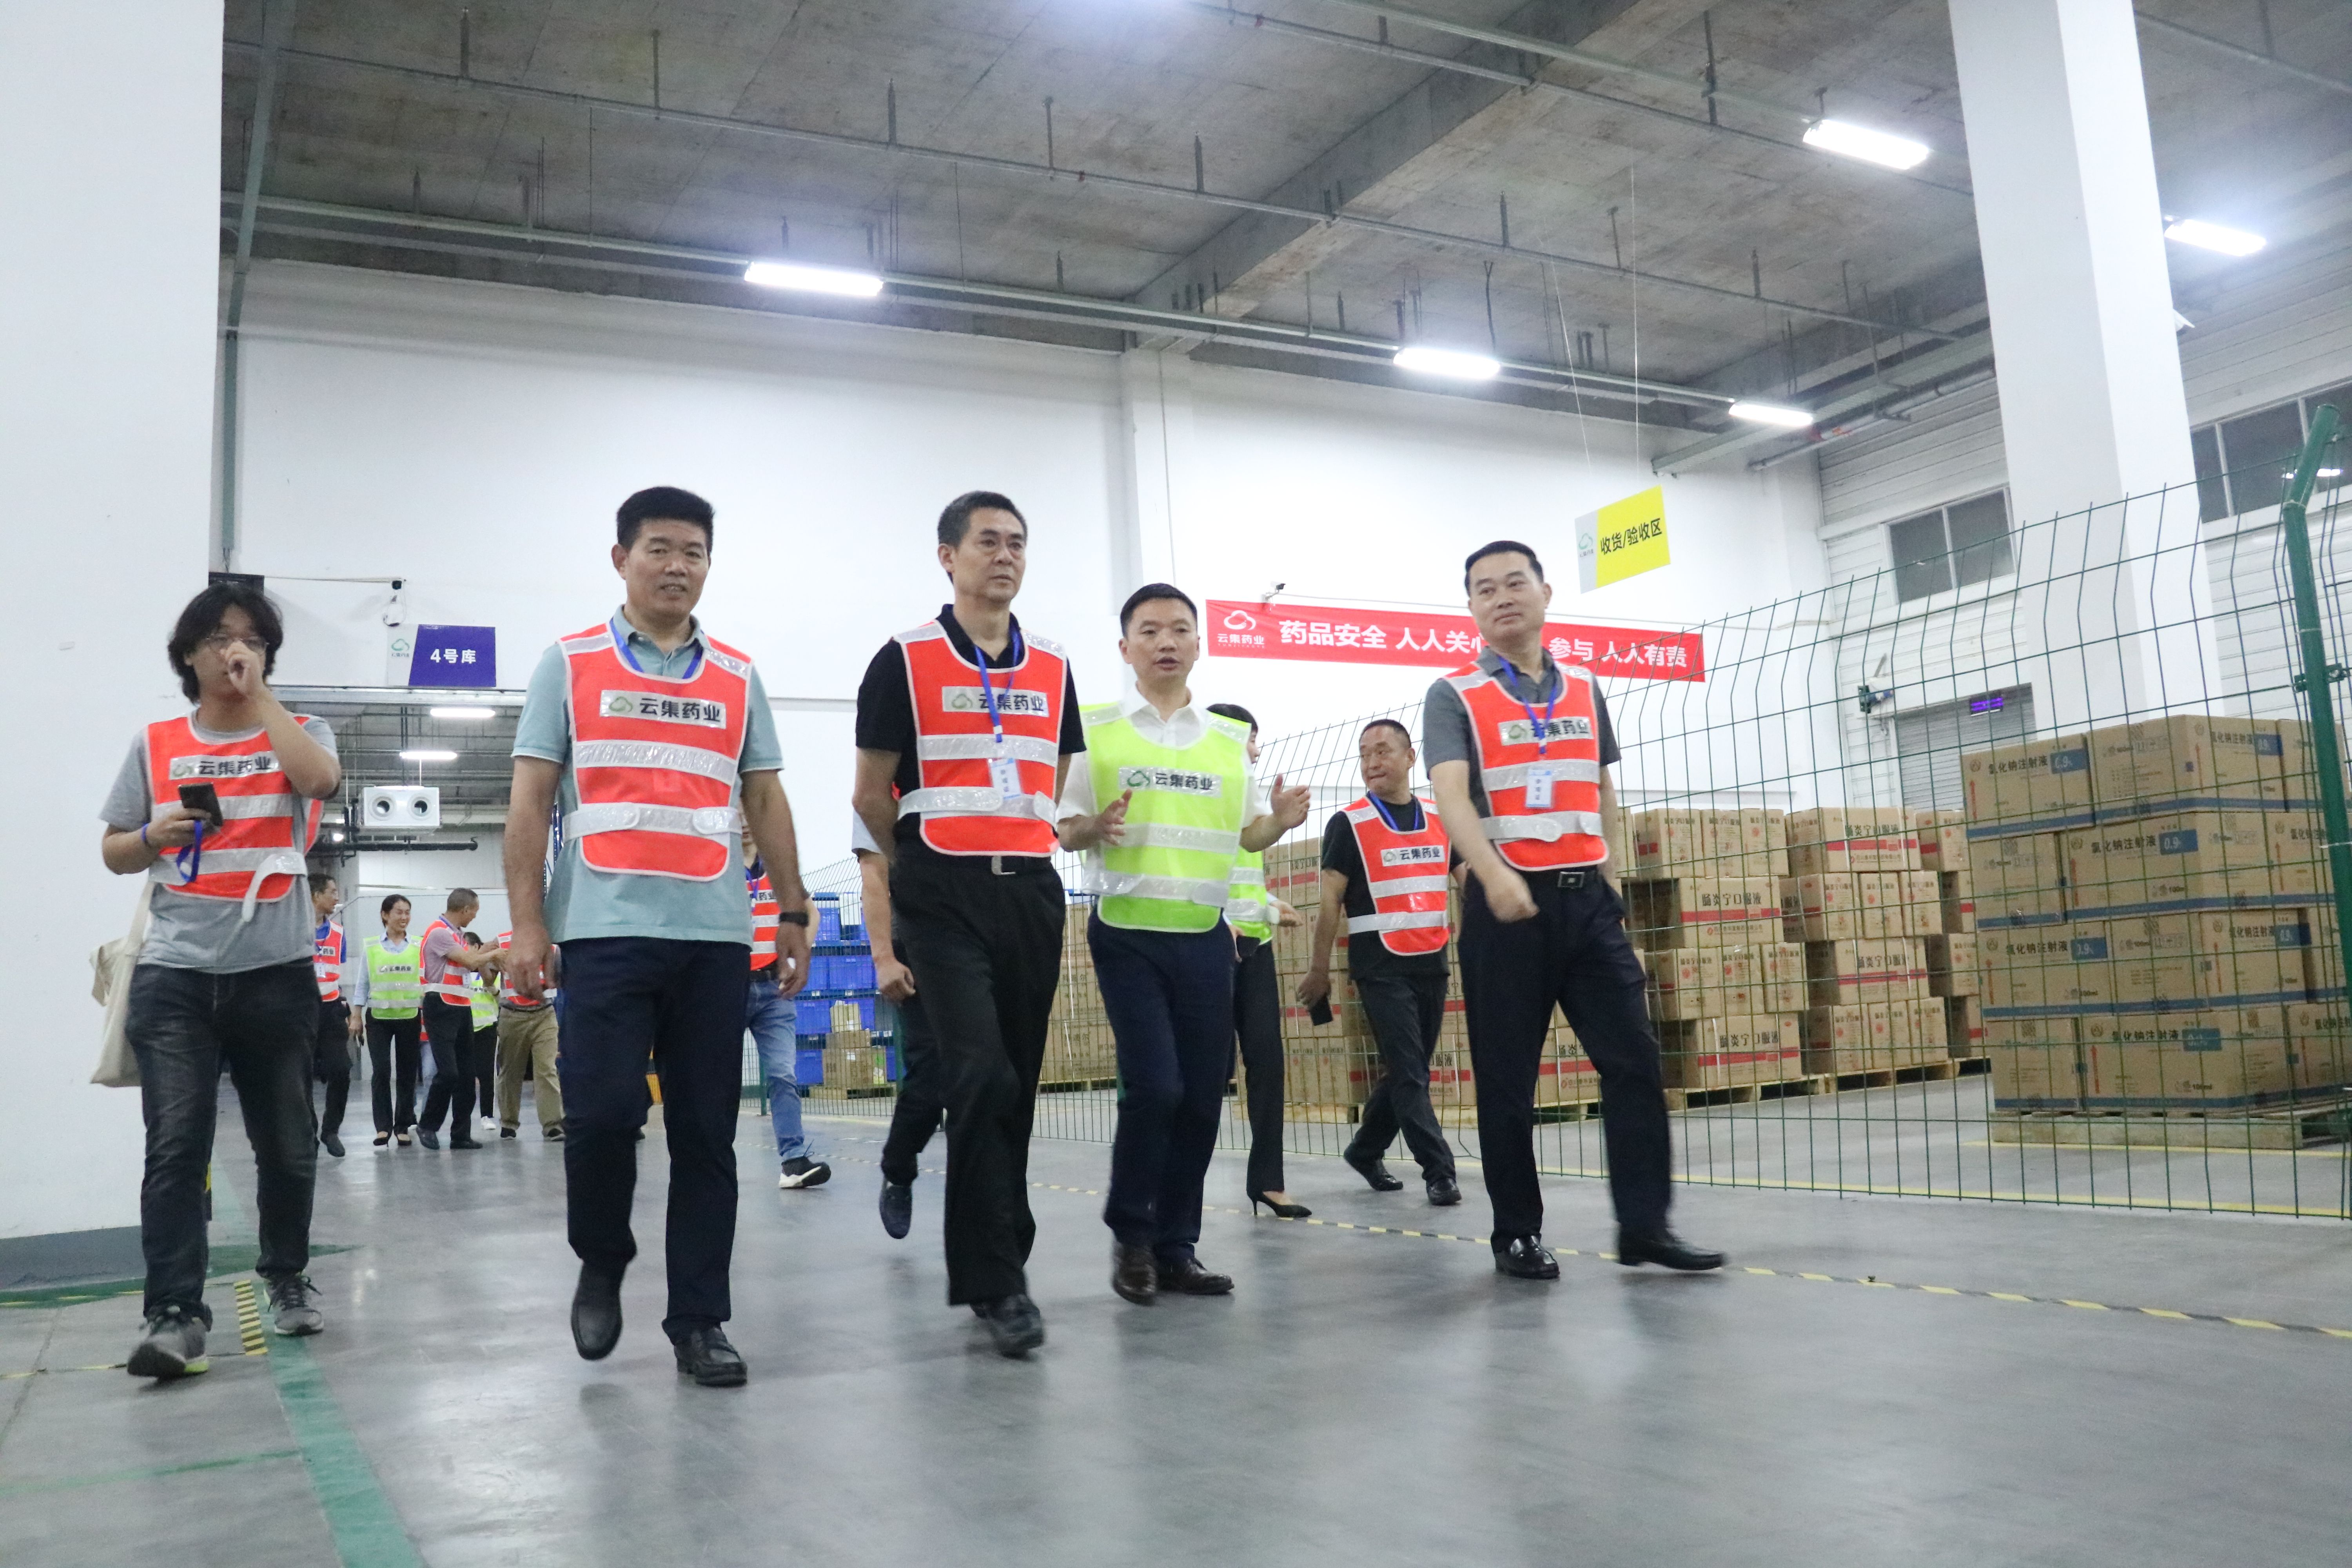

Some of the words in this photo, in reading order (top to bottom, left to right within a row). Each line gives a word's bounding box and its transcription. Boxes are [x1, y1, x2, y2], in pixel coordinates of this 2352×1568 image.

[1601, 518, 1662, 555] 收货/验收区
[1217, 633, 1265, 645] 云集药业
[1279, 620, 1387, 649] 药品安全
[1549, 637, 1593, 661] 参与
[1601, 641, 1688, 668] 人人有责
[430, 648, 476, 664] 4号库
[639, 698, 720, 722] 云集药业
[978, 694, 1044, 711] 云集药业
[199, 756, 273, 775] 云集药业
[1155, 772, 1213, 791] 云集药业
[1400, 847, 1441, 860] 云集药业
